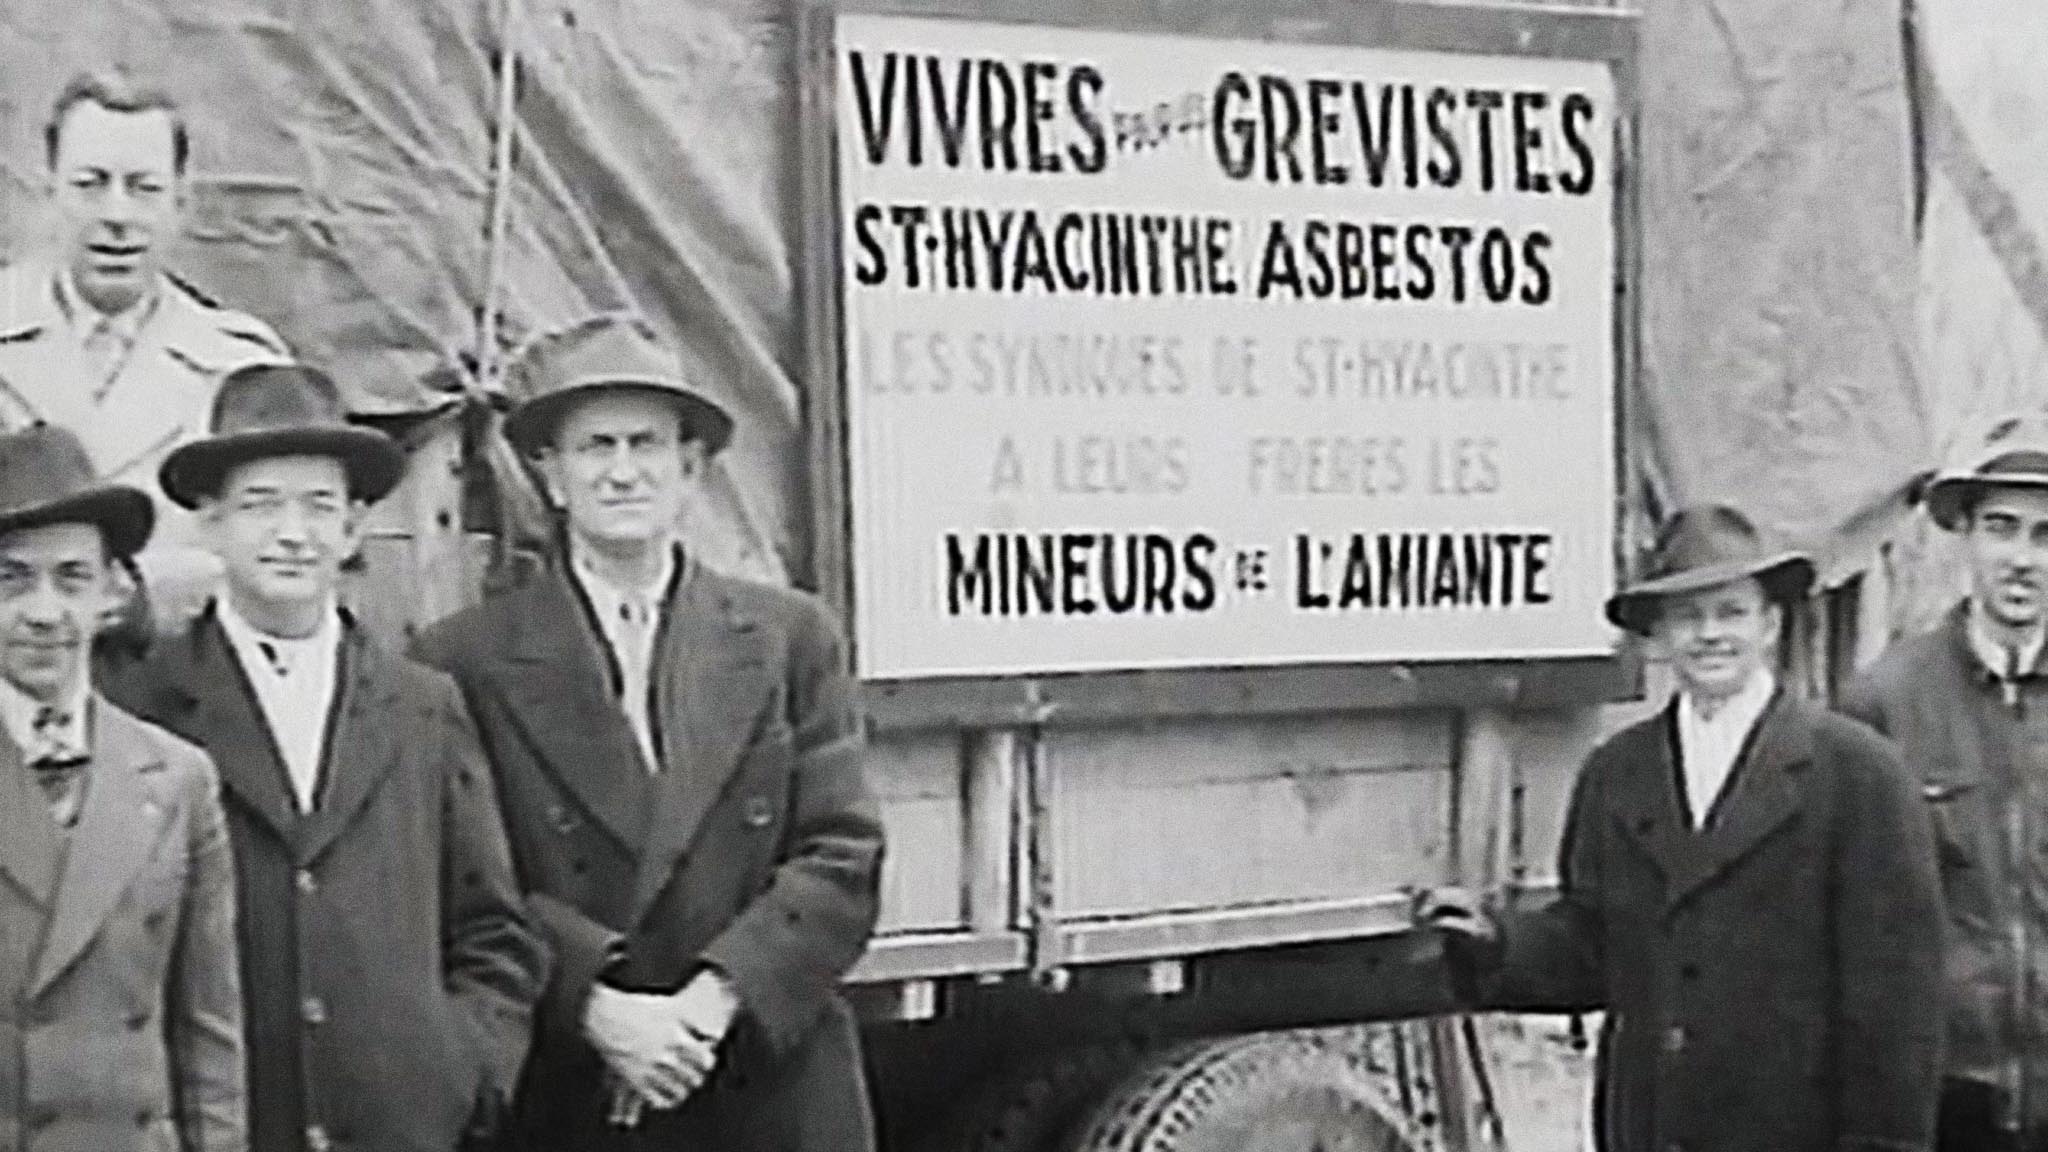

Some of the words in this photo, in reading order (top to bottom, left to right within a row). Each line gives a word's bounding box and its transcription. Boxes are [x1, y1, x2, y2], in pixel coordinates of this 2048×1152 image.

[849, 51, 1107, 174] VIVRES
[1213, 73, 1595, 197] GREVISTES
[1258, 221, 1552, 306] ASBESTOS
[862, 328, 953, 395] LES
[1214, 336, 1260, 398] DE
[1054, 434, 1189, 495] LEURS
[1429, 437, 1501, 498] LES
[946, 534, 1217, 617] MINEURS
[1296, 534, 1552, 610] L'AMIANTE
